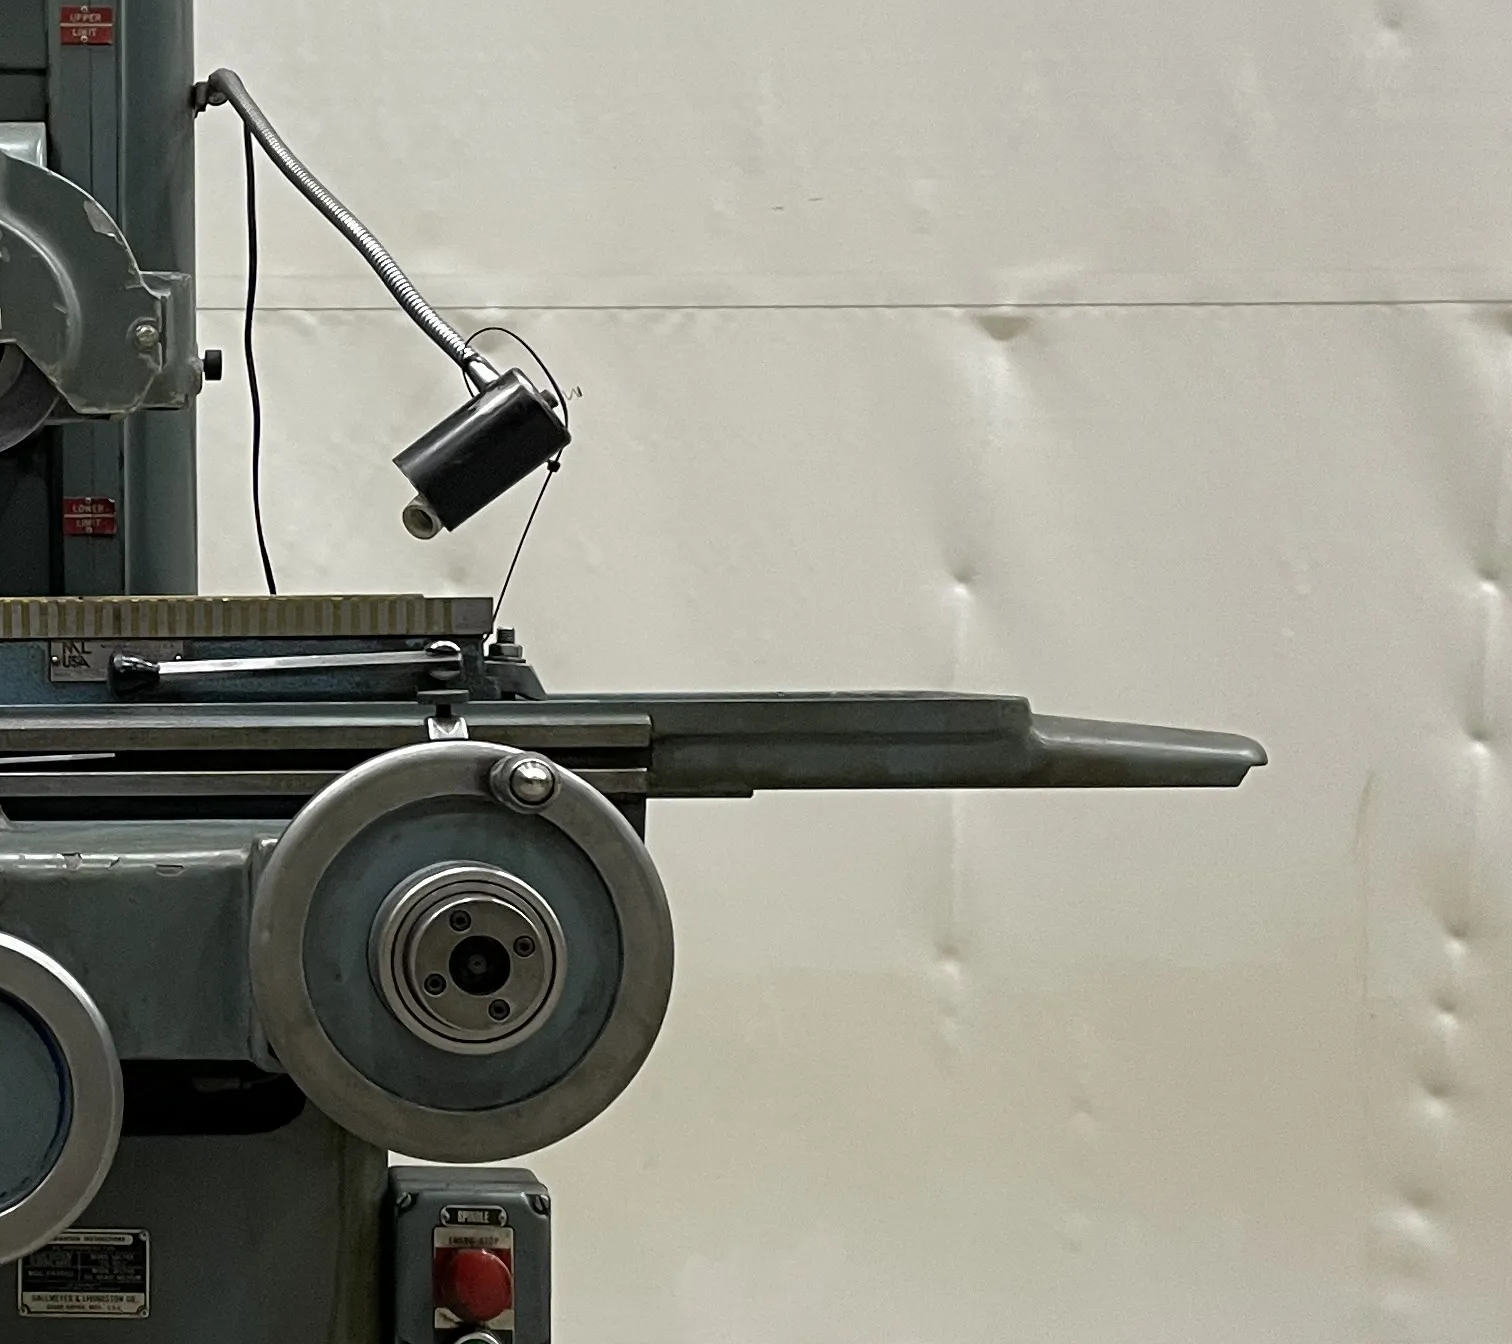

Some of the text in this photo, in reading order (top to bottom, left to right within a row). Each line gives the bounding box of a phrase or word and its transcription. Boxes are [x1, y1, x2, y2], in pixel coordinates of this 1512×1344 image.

[69, 13, 102, 23] UPPER
[71, 27, 97, 37] LIMIT
[72, 503, 104, 513] LOWER
[76, 518, 101, 527] LIMIT
[62, 655, 91, 669] USA
[457, 1209, 490, 1224] SPINDLE
